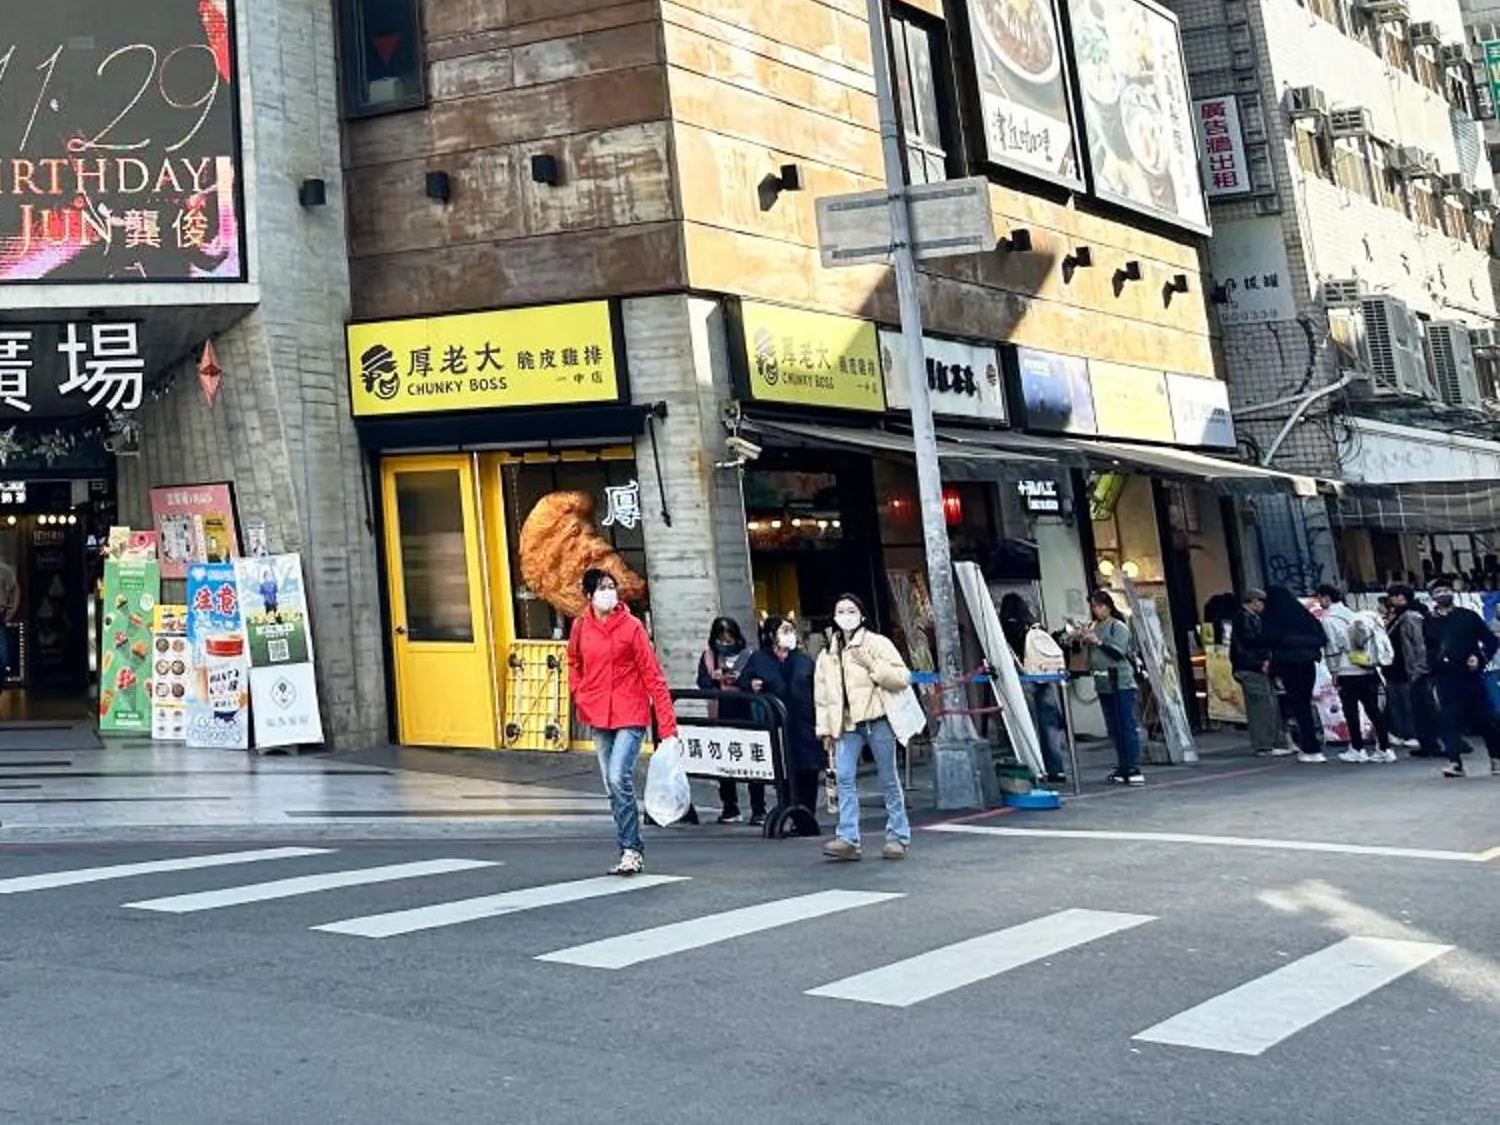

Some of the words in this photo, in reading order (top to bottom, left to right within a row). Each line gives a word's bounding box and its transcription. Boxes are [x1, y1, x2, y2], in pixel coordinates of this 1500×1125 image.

[407, 340, 504, 378] 厚老大
[517, 345, 603, 371] 脆皮雞排
[407, 379, 463, 397] CHUNKY
[470, 376, 508, 392] BOSS
[687, 738, 766, 762] 請勿停車
